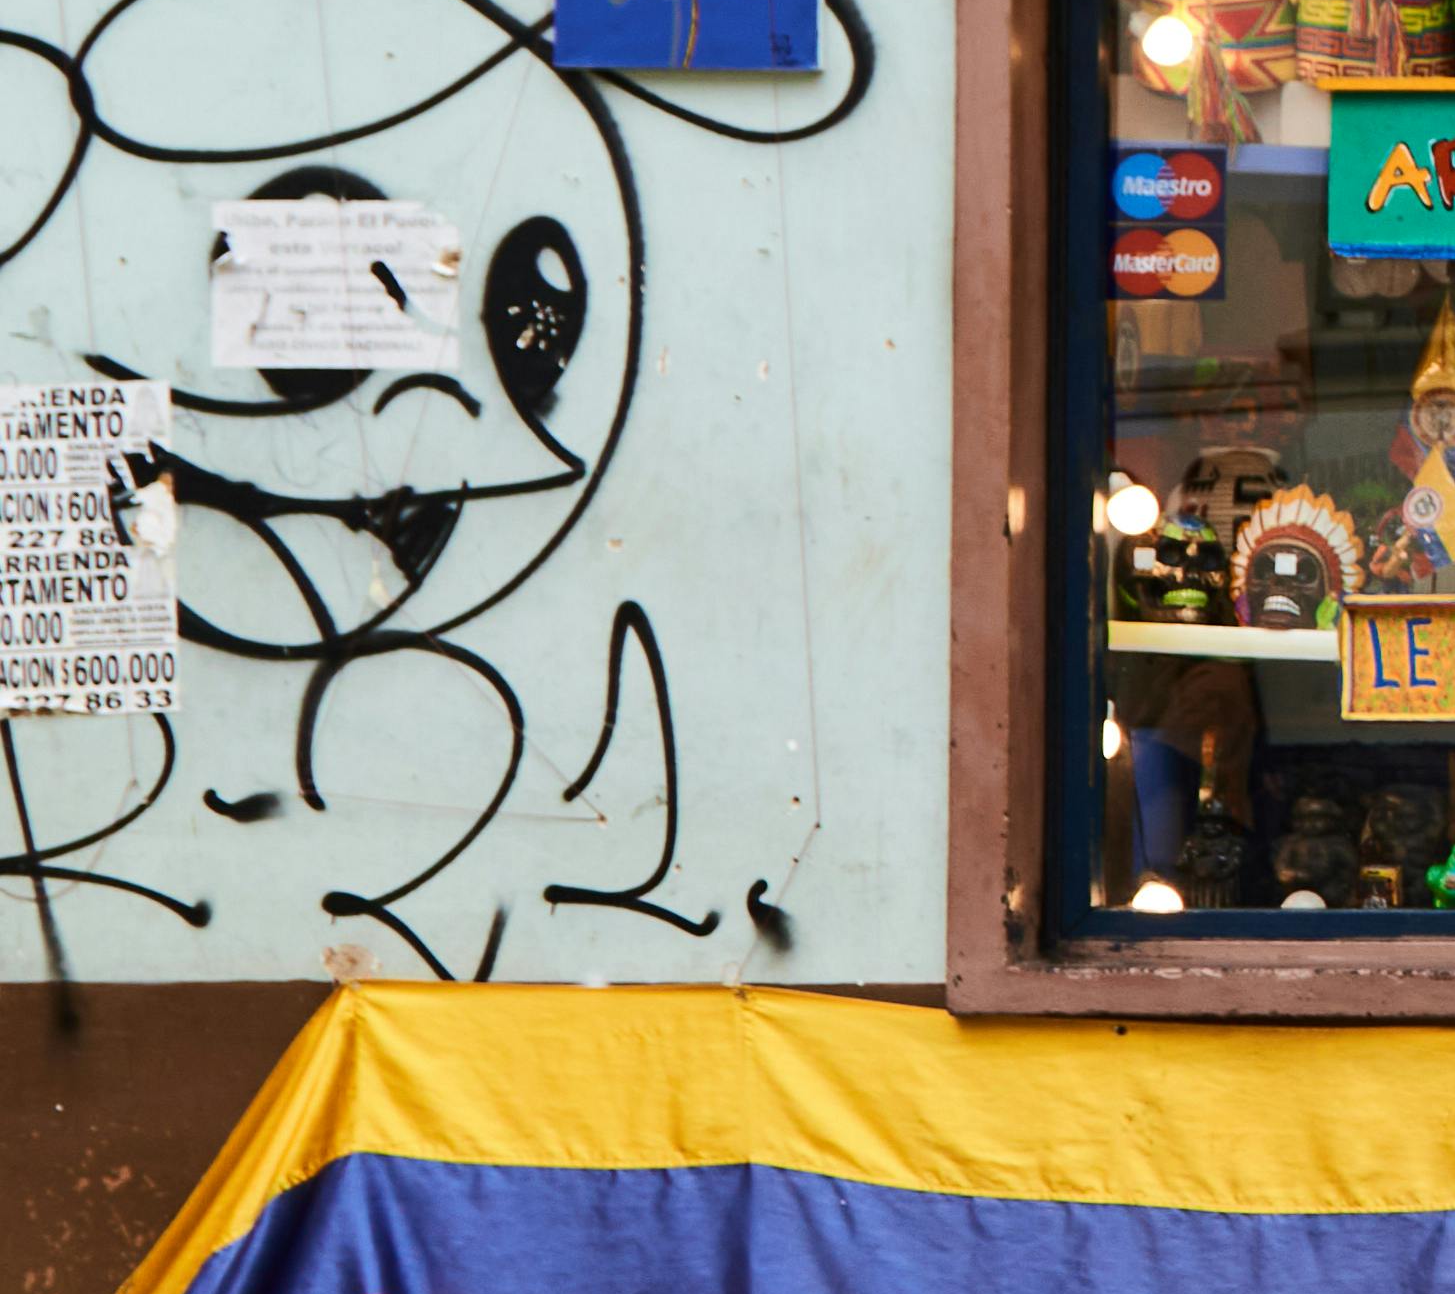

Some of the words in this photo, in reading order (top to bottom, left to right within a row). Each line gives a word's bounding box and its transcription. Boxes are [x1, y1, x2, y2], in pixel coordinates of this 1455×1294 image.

[1122, 175, 1212, 197] Maestro
[1114, 252, 1217, 274] MasterCard
[9, 528, 64, 549] 227
[0, 551, 130, 574] RRIENDA
[1368, 616, 1438, 689] LE
[135, 689, 172, 709] 33
